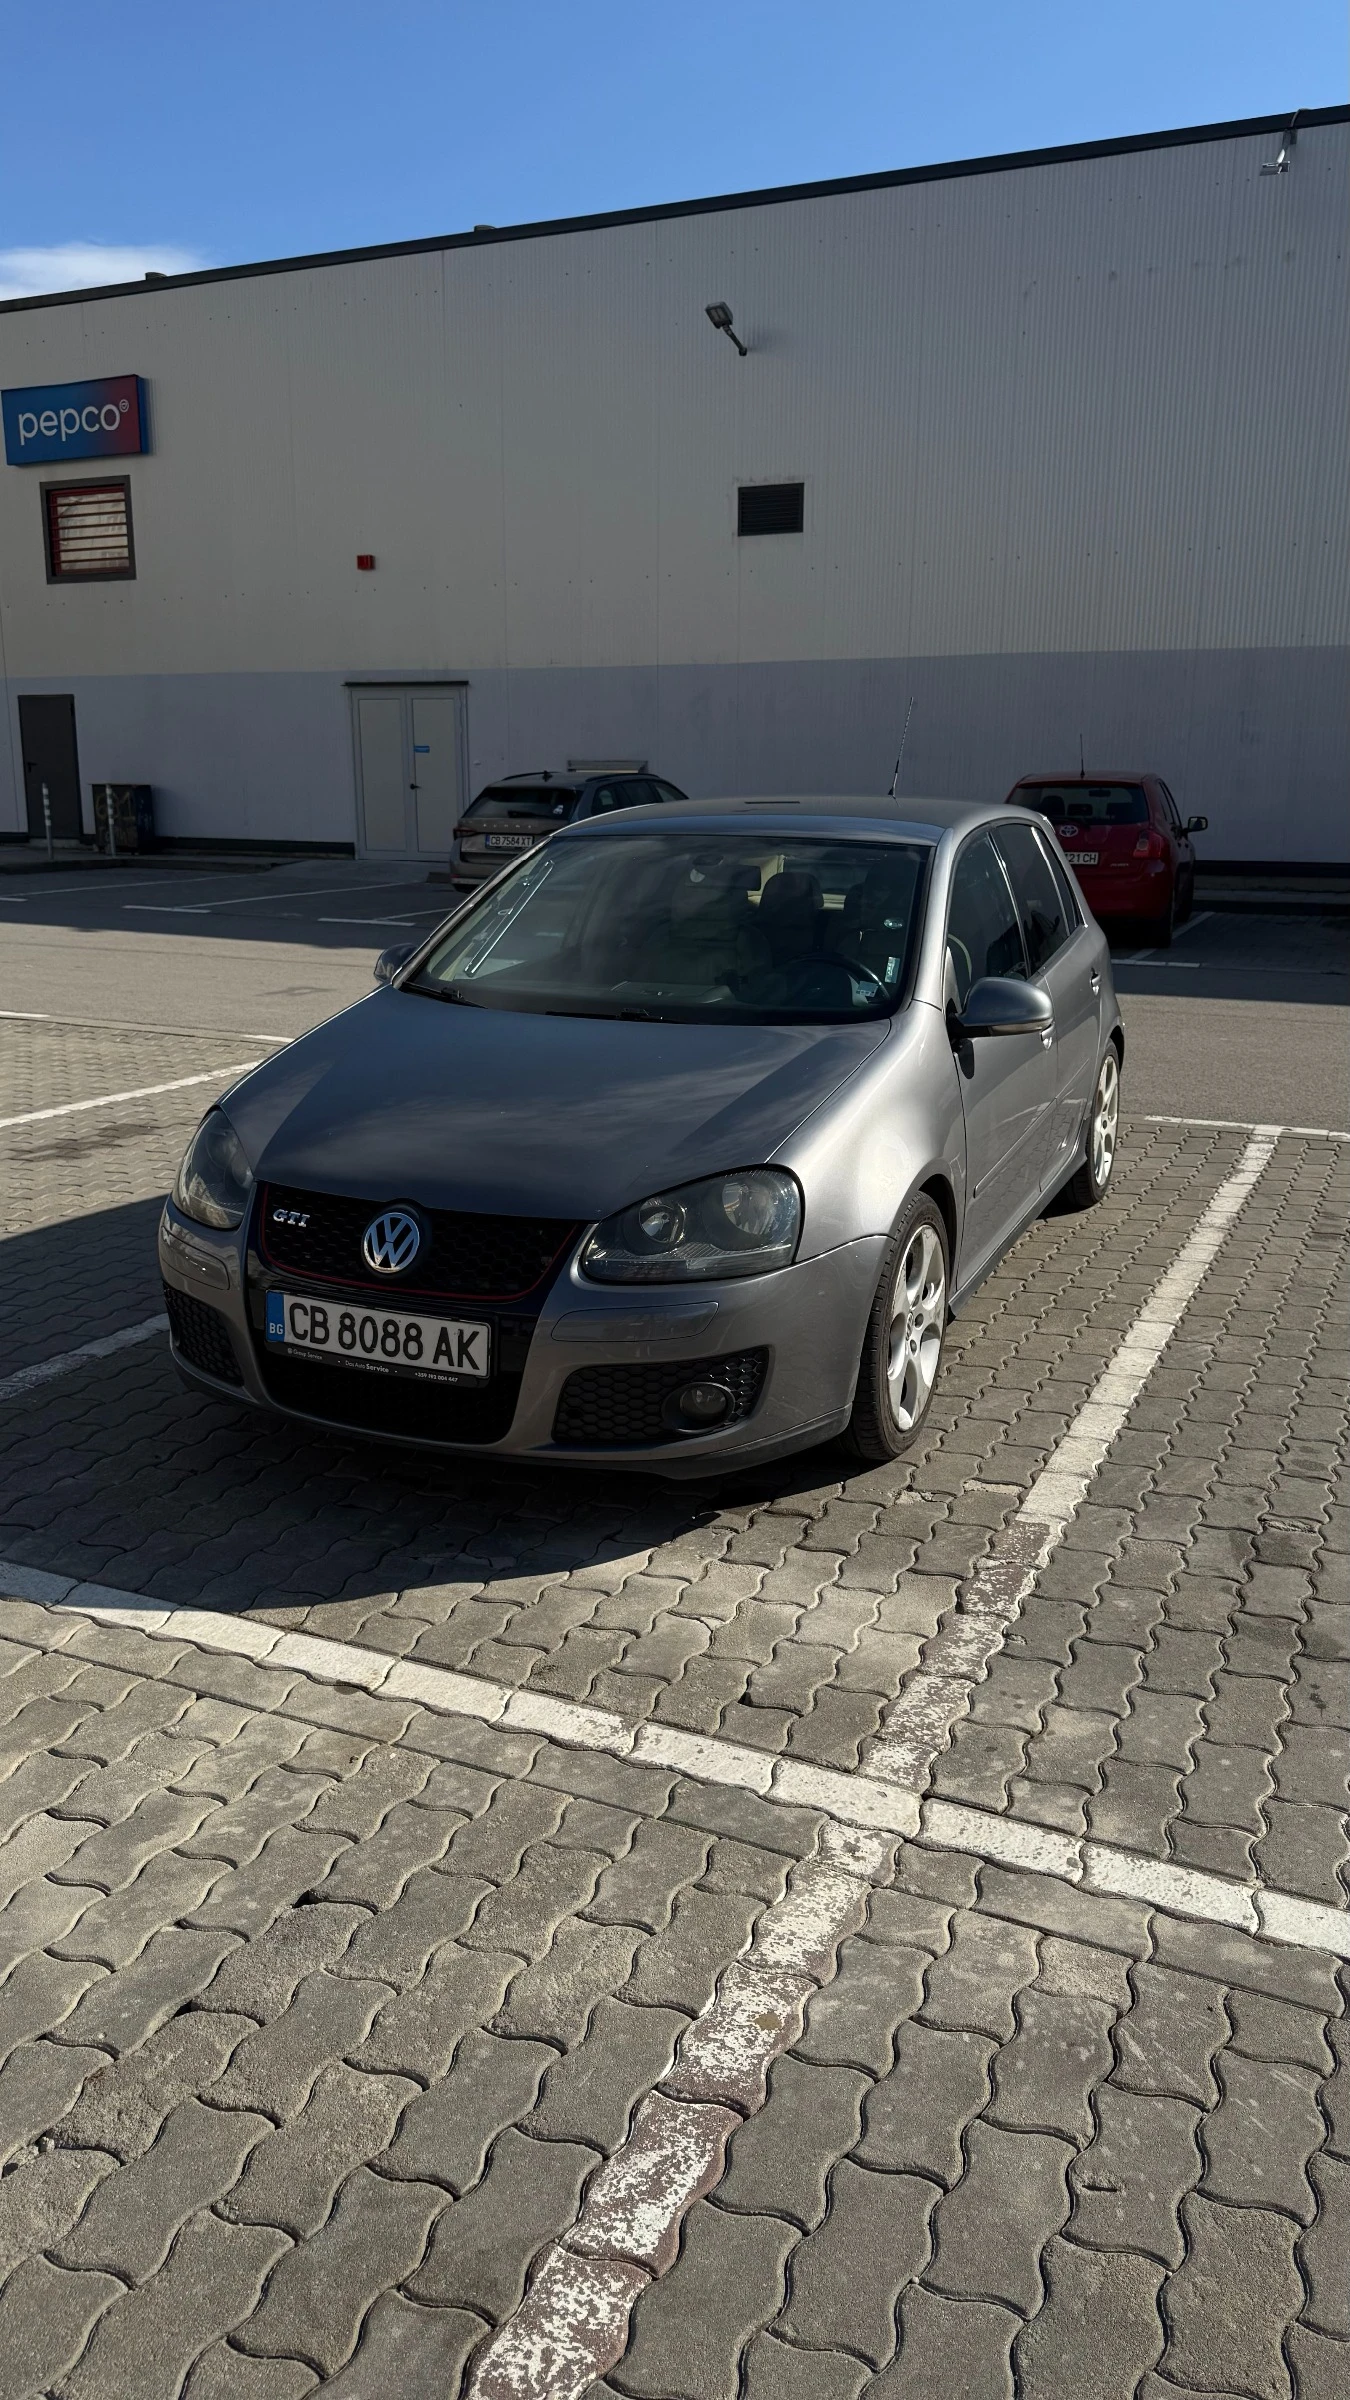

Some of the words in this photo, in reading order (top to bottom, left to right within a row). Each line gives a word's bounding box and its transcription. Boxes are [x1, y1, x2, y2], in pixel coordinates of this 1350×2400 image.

[491, 836, 501, 845] CB
[502, 836, 520, 845] 7584
[522, 836, 531, 846] XT
[1083, 854, 1096, 863] CH
[272, 1208, 311, 1228] GTI
[269, 1322, 284, 1335] BG
[289, 1302, 330, 1345] CB
[338, 1311, 424, 1361] 8088
[432, 1326, 480, 1371] AK
[354, 1362, 366, 1370] Auto
[366, 1363, 390, 1373] Service
